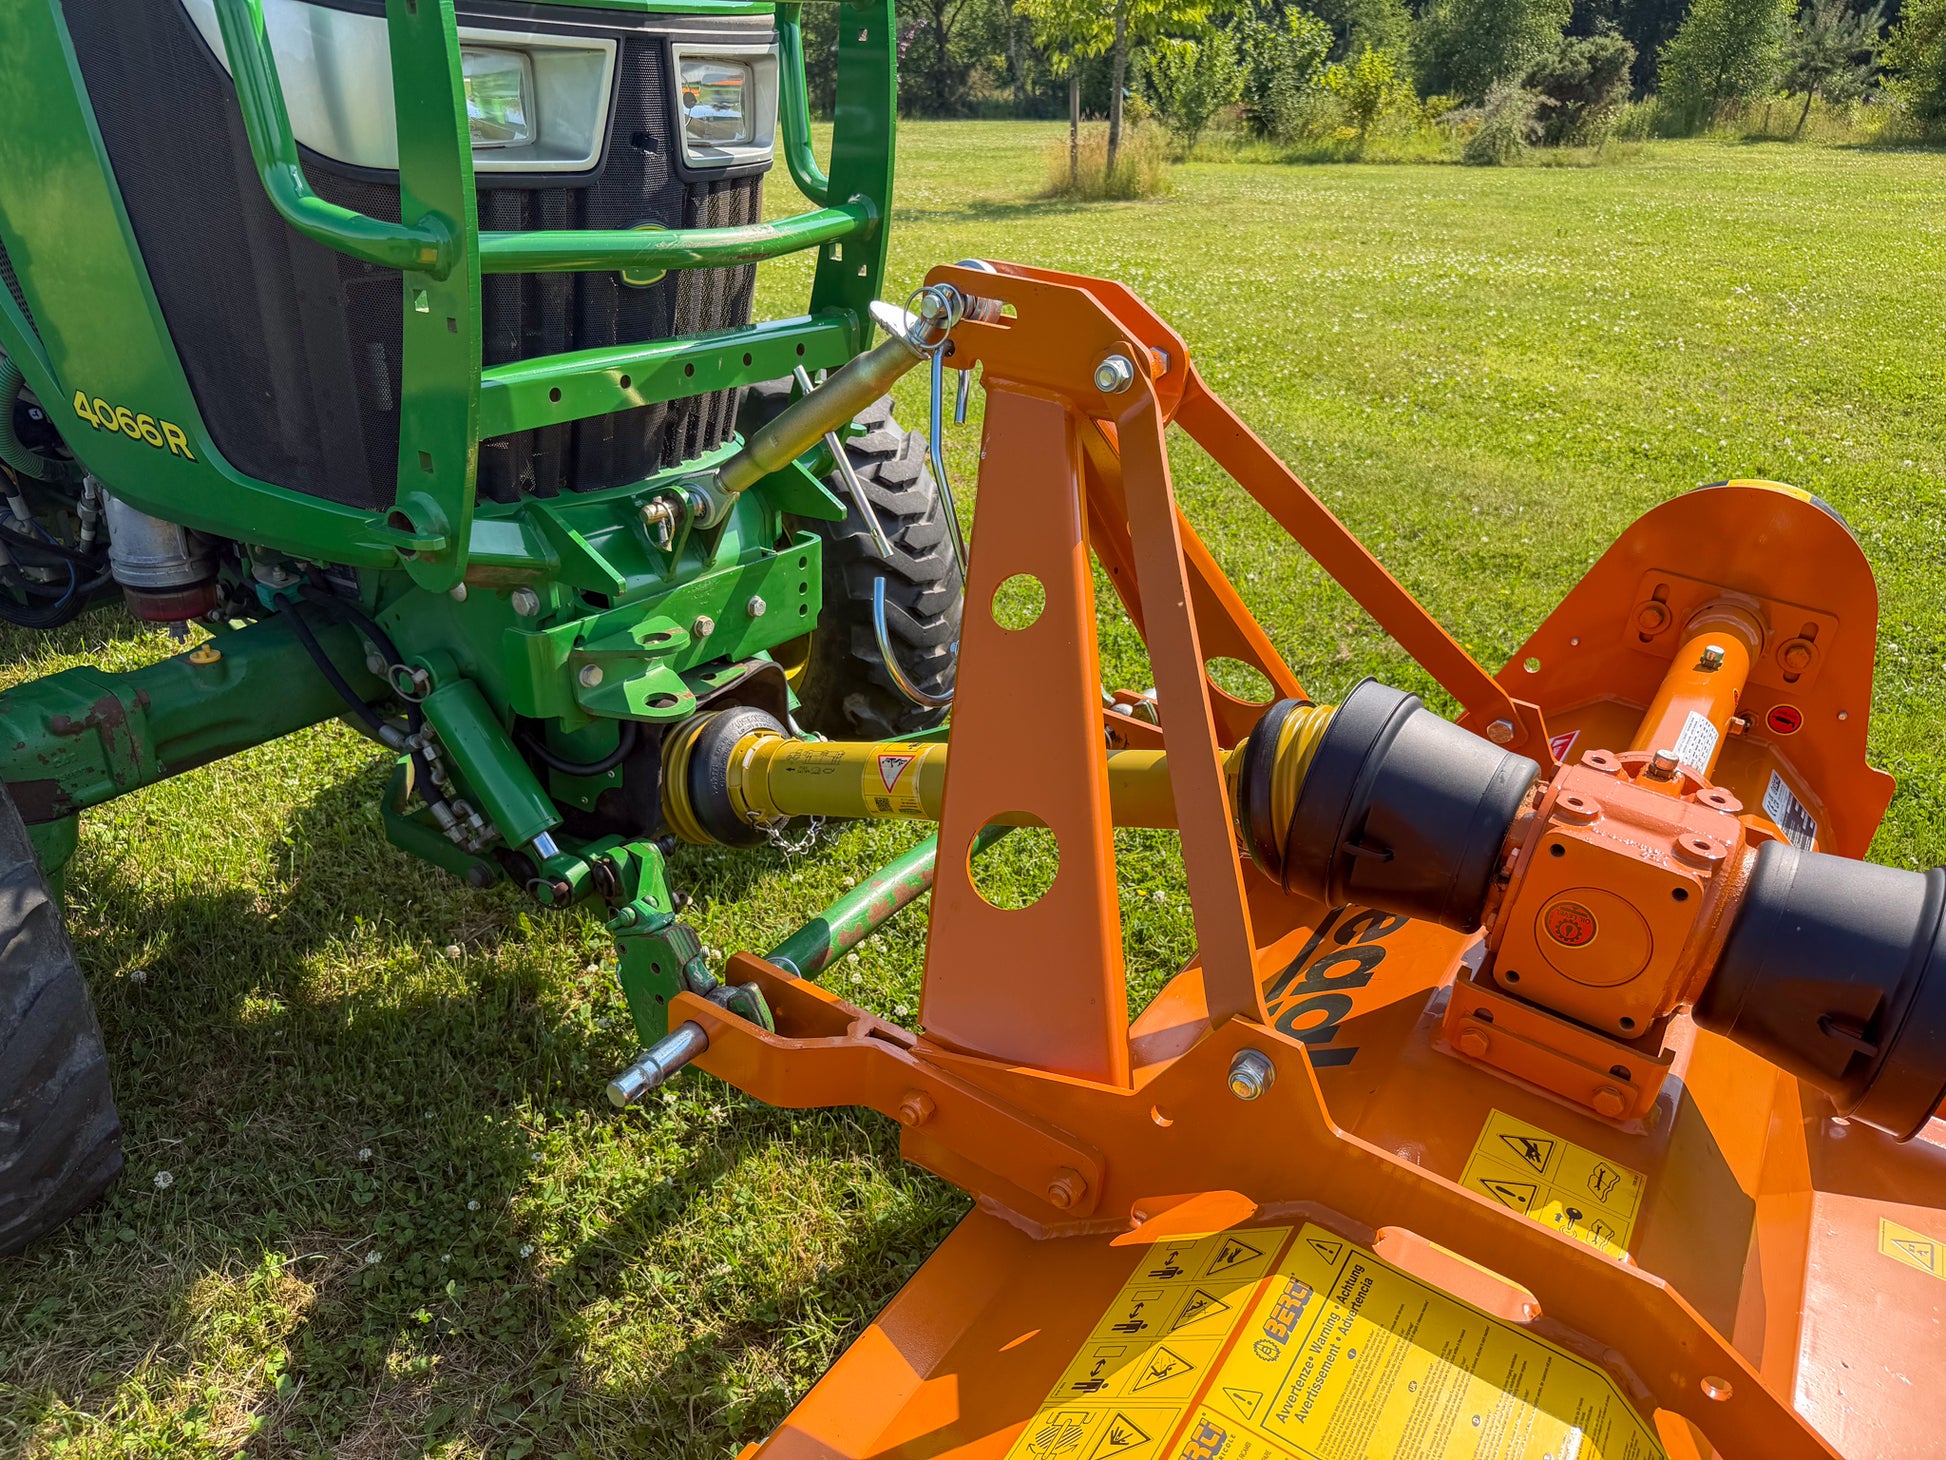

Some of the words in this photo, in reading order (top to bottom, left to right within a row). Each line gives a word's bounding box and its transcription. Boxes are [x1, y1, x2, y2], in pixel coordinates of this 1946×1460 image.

[74, 389, 197, 462] 4066R
[1275, 1360, 1314, 1424] Avvertenze
[1309, 1311, 1341, 1355] Warning
[1335, 1263, 1365, 1305] Achtung
[1294, 1342, 1342, 1424] Avertissement
[1337, 1277, 1374, 1337] Advertencia
